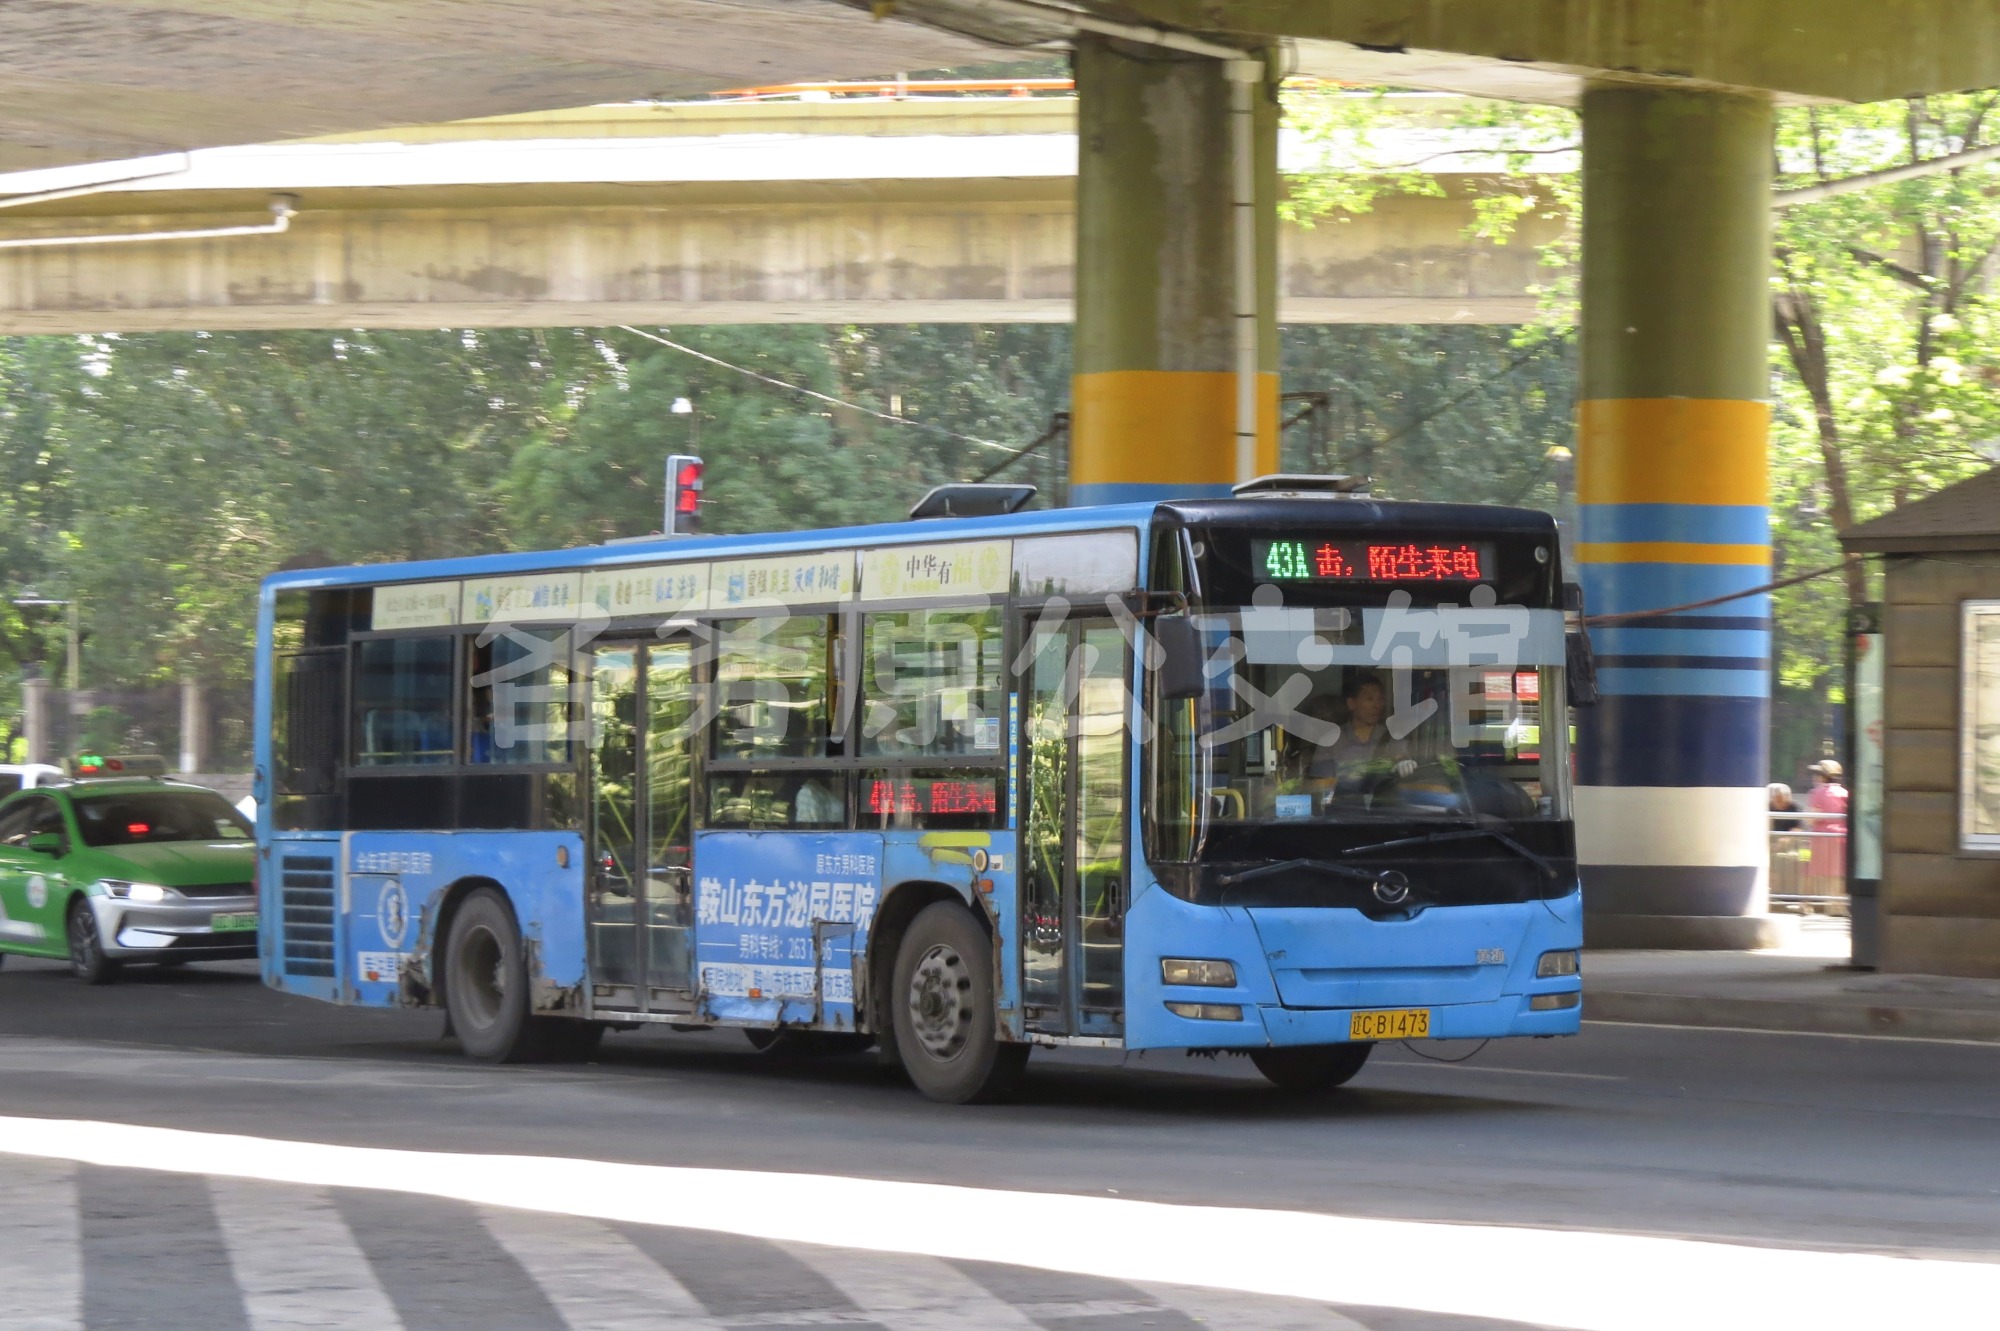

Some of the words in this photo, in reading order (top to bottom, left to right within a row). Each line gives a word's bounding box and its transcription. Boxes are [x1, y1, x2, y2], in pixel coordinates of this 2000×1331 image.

[1266, 542, 1309, 577] 43A
[698, 876, 876, 931] 鞍山东方泌尿医院
